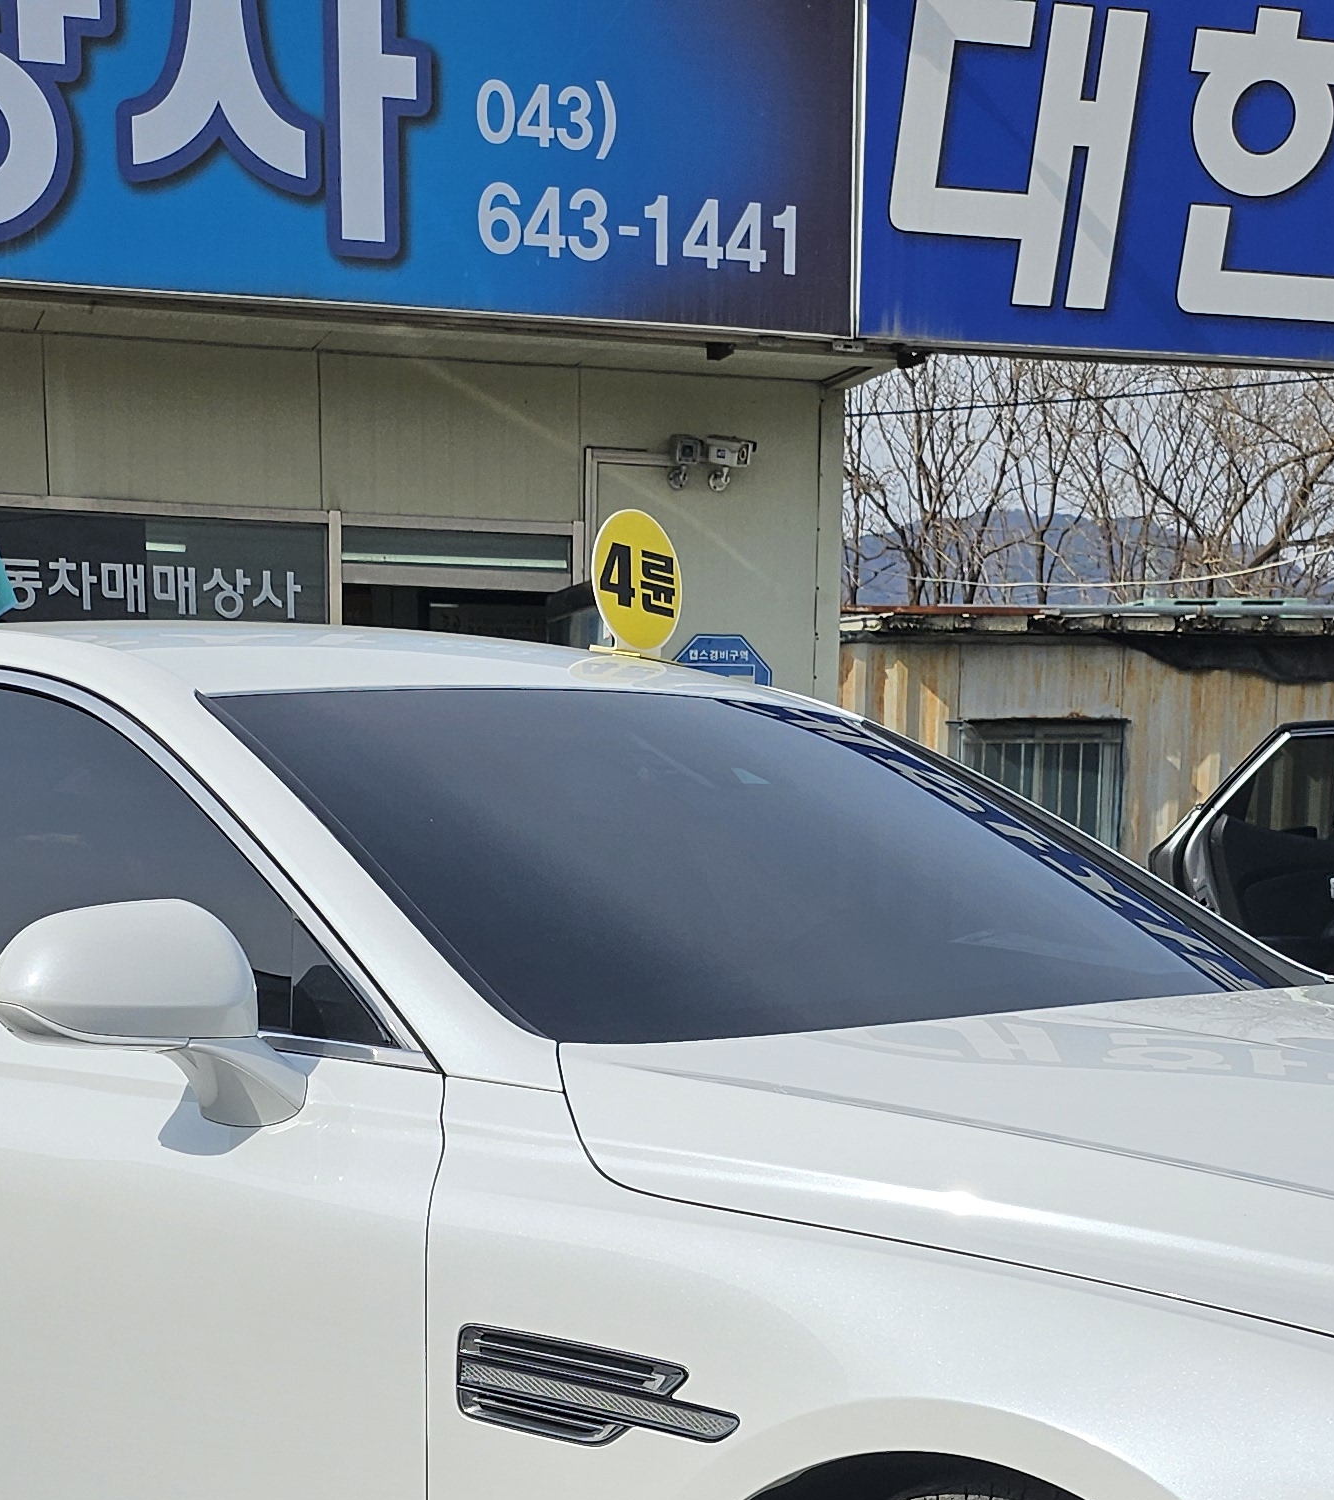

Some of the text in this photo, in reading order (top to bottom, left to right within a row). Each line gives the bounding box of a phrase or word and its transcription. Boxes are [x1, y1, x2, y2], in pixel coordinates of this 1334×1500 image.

[476, 79, 618, 160] 043)
[478, 181, 797, 275] 643-1441
[600, 541, 676, 619] 4륜
